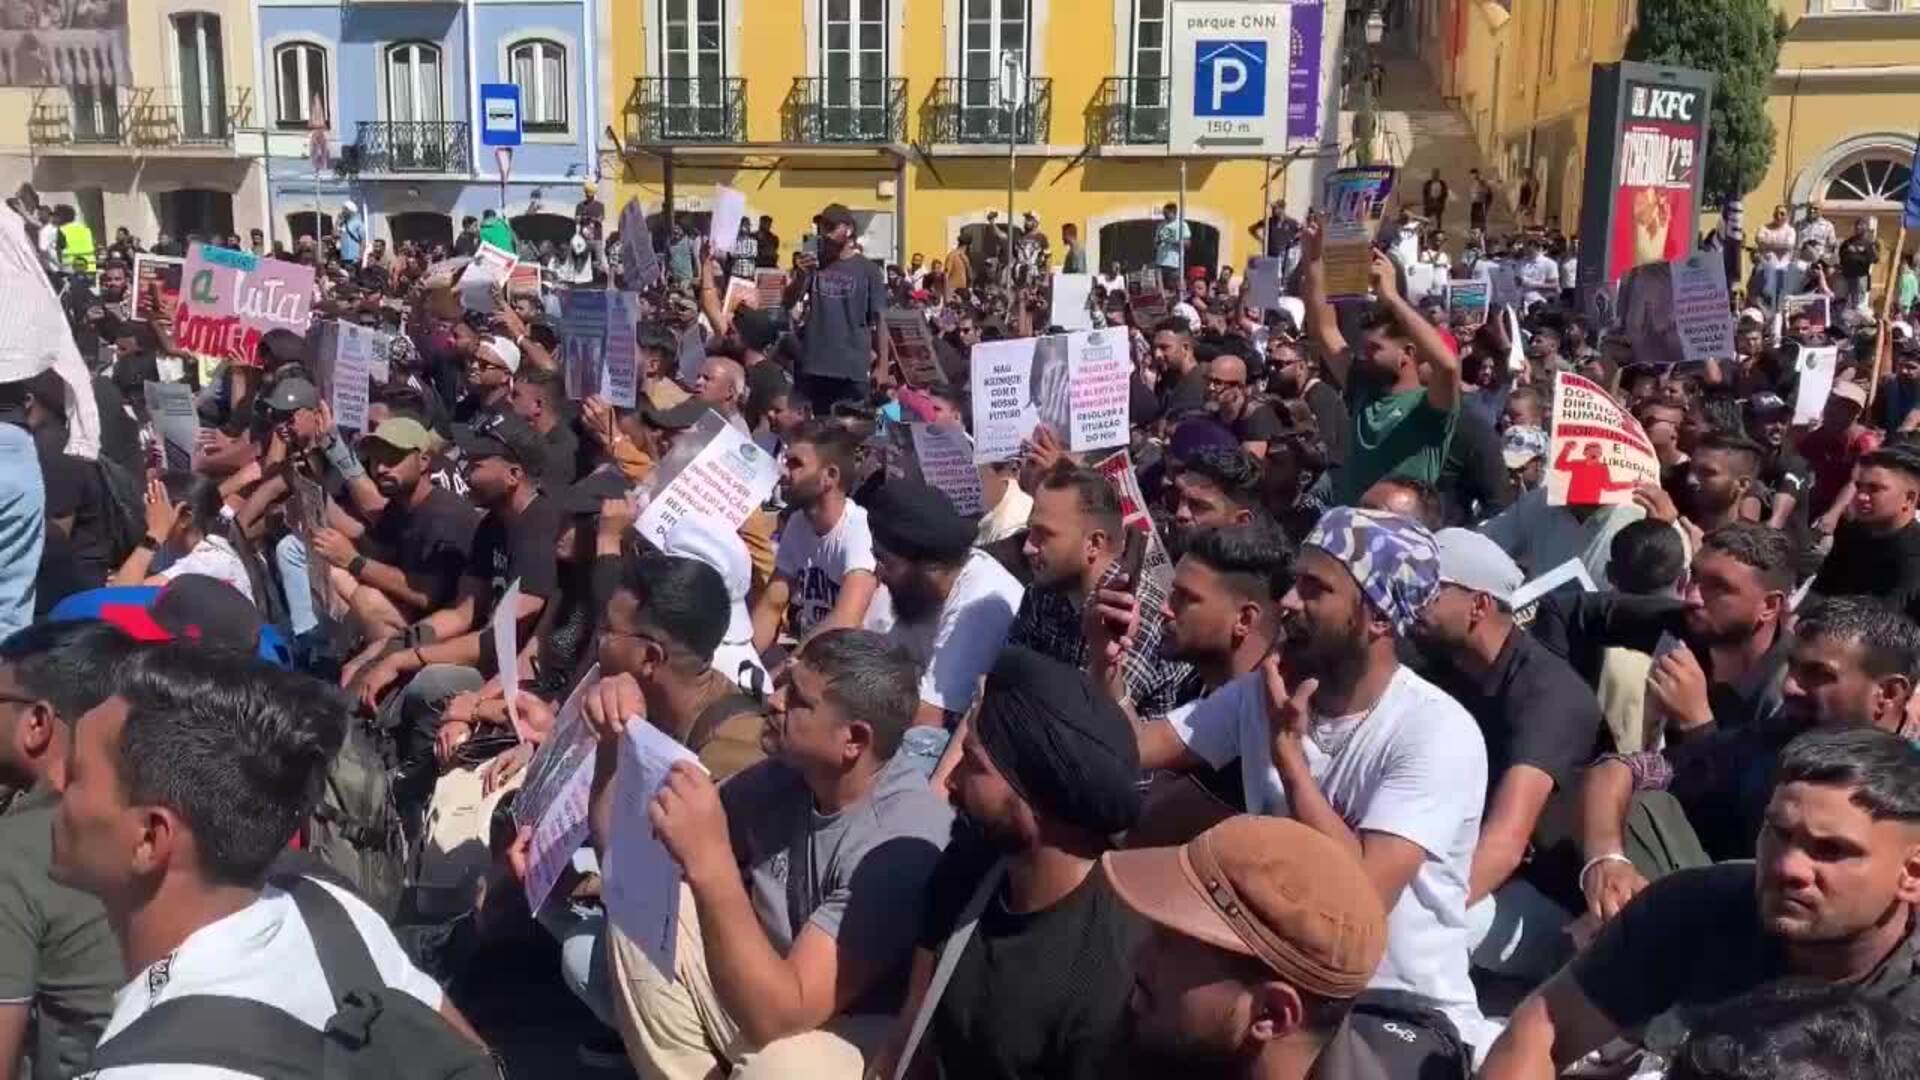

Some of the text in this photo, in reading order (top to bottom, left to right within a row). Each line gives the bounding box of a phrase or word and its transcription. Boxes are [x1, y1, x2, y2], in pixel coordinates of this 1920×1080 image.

[1188, 15, 1277, 29] parque CNN
[1211, 56, 1248, 110] P
[1648, 88, 1697, 121] KFC
[1207, 120, 1250, 134] 150 m
[991, 398, 1018, 409] NOSSO
[1613, 443, 1622, 454] E
